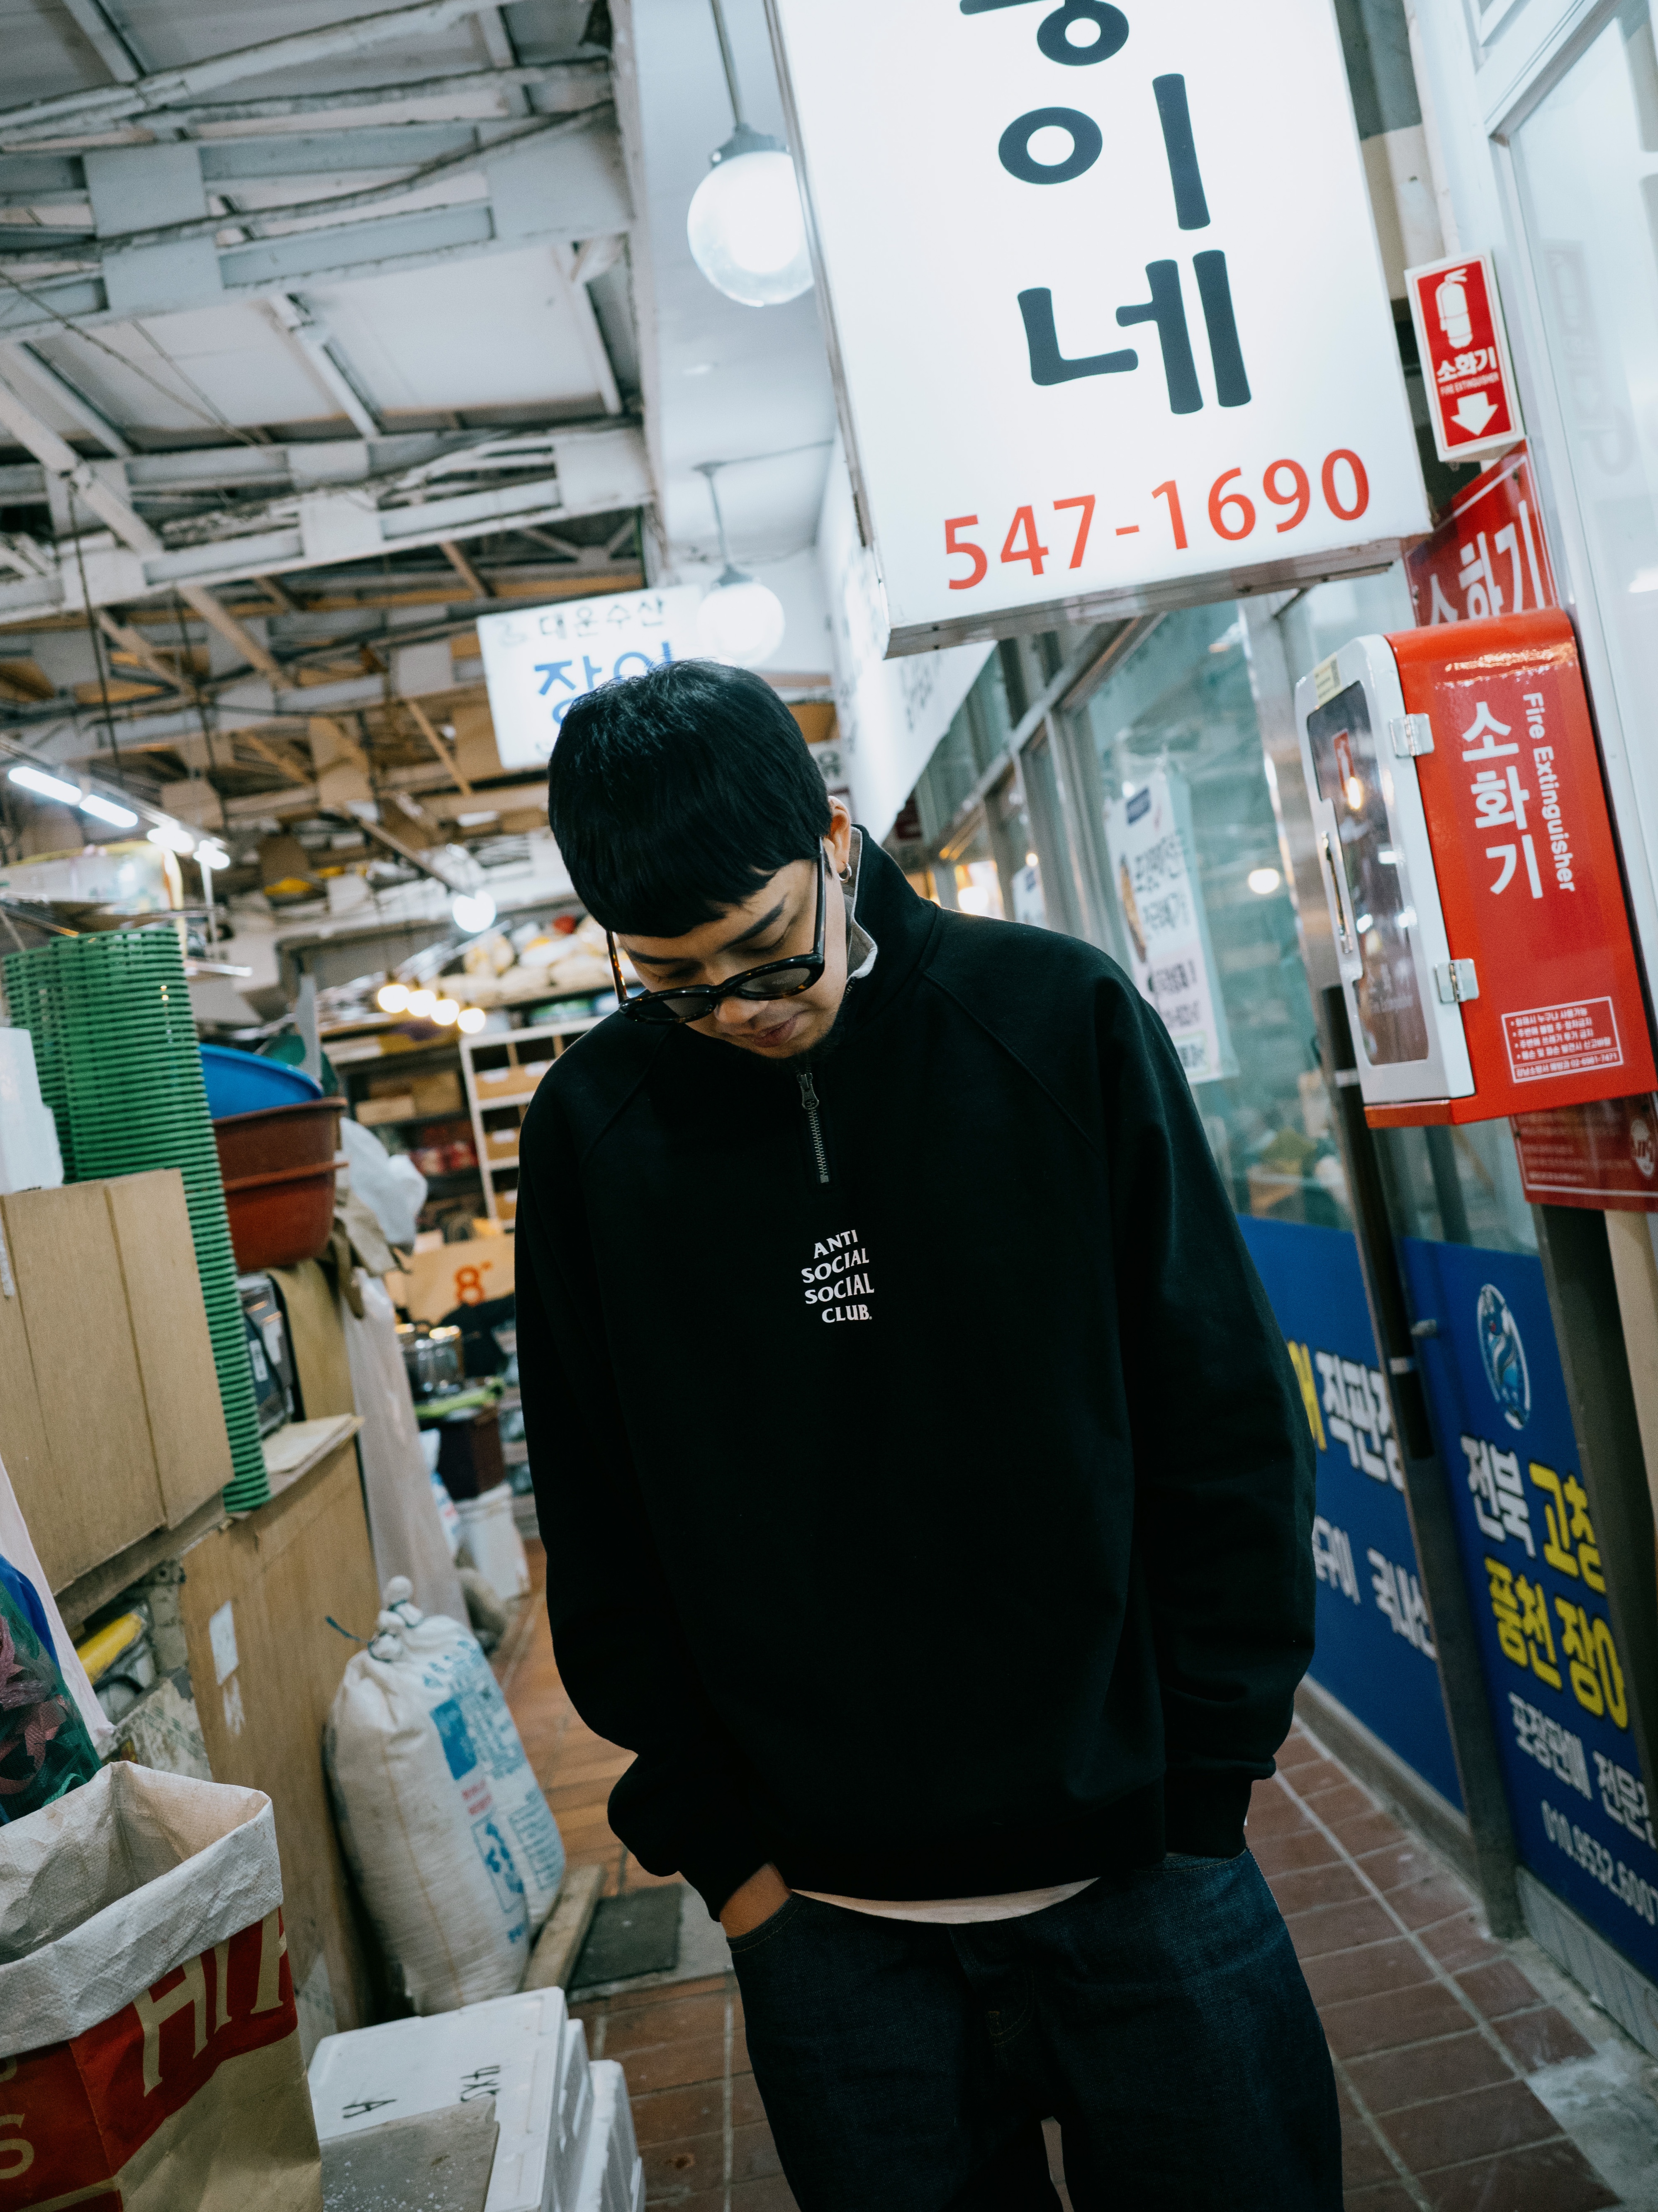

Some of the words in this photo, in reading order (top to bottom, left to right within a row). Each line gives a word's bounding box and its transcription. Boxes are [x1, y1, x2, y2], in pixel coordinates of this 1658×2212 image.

[1436, 346, 1497, 383] 소화기
[943, 448, 1370, 591] 547-1690
[538, 596, 665, 639] 대운수산
[1522, 691, 1545, 740] Fire
[1462, 701, 1544, 899] 소화기
[1533, 747, 1575, 892] Extinguisher
[801, 1247, 870, 1283] SOCIAL
[813, 1229, 858, 1259] ANTI
[804, 1273, 874, 1304] SOCIAL
[1461, 1434, 1536, 1559] 전북
[1484, 1557, 1562, 1691] 풍천
